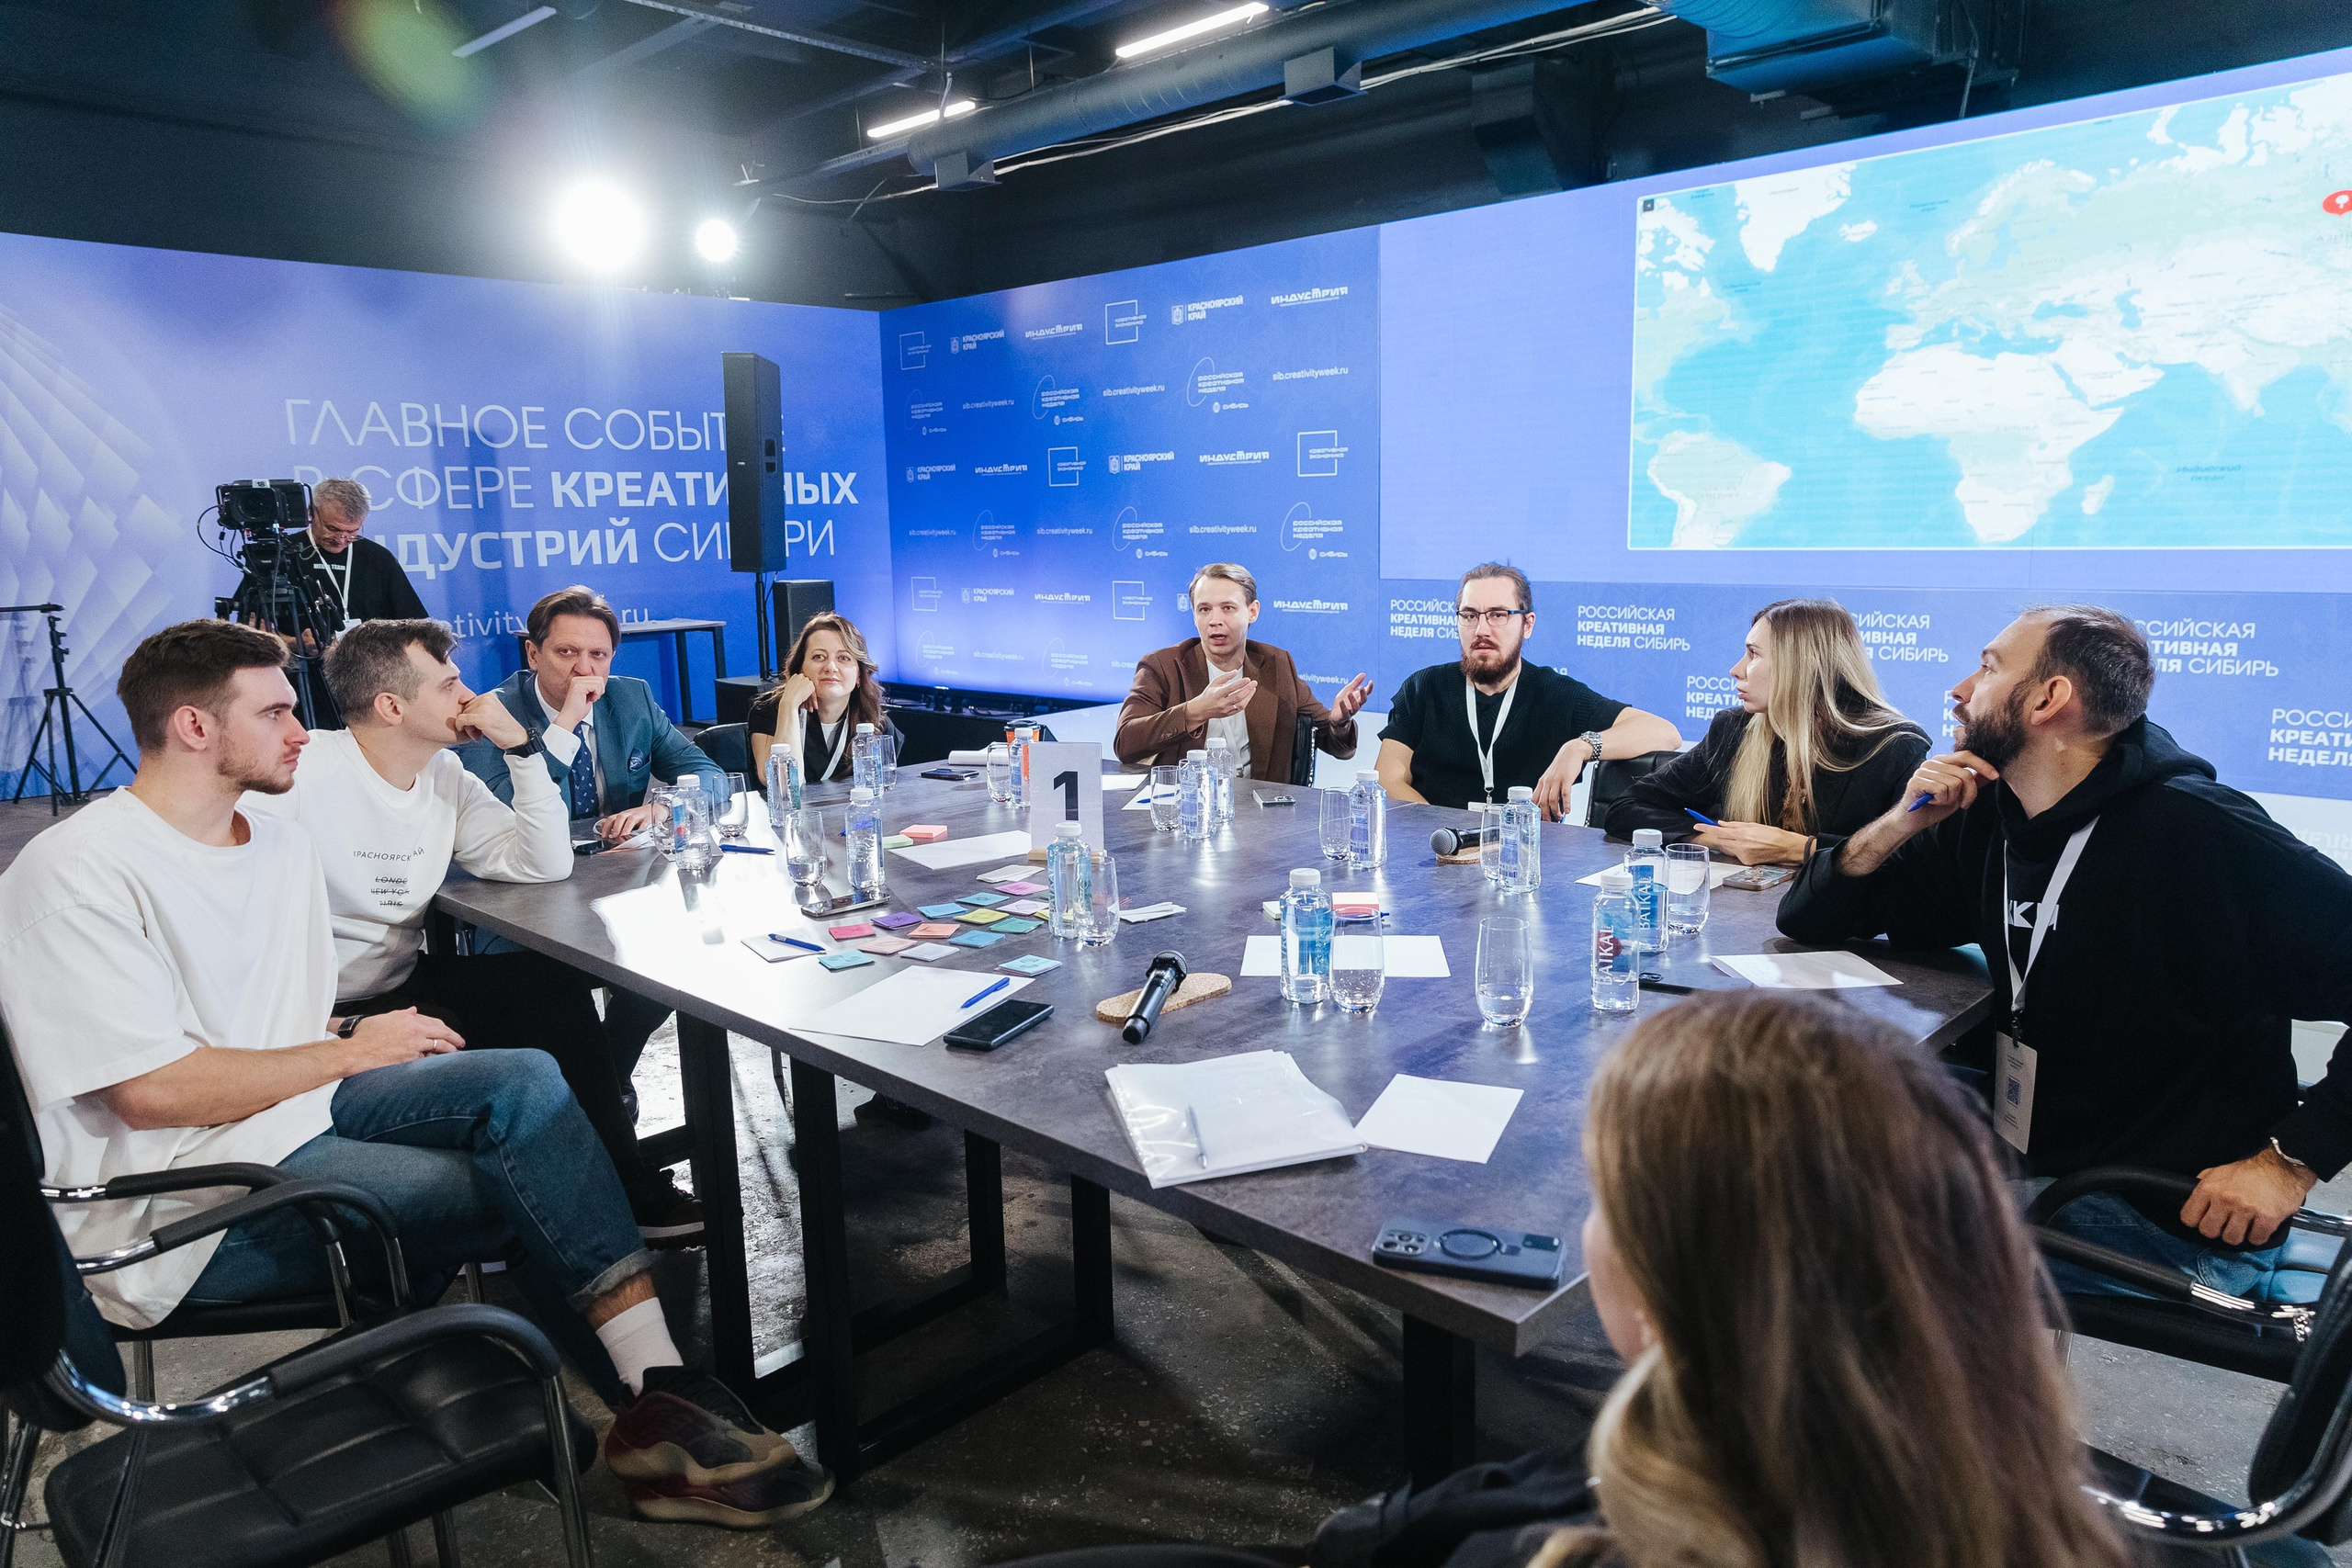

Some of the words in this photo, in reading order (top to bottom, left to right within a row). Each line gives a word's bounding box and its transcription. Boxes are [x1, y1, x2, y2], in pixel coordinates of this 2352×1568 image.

[1188, 295, 1243, 311] КРАСНОЯРСКИЙ
[1188, 310, 1206, 321] КРАЙ
[1272, 367, 1349, 381] sib.creativityweek.ru
[1102, 384, 1165, 397] sib.creativityweek.ru
[285, 399, 548, 448] ГЛАВНОЕ
[564, 407, 786, 452] СОБЫТ
[1124, 451, 1174, 462] КРАСНОЯРСКИЙ
[1124, 461, 1141, 471] КРАЙ
[551, 471, 860, 508] КРЕАТИЫХ
[1036, 527, 1092, 536] sib.creativityweek.ru
[1189, 525, 1257, 536] sib.creativityweek.ru
[375, 517, 638, 580] ДУСТРИЙ
[653, 519, 834, 562] СИРИ
[1390, 598, 1455, 613] РОССИЙСК
[1577, 604, 1675, 621] РОССИЙСКАЯ
[1850, 610, 1930, 629] ИЙСКАЯ
[1390, 626, 1434, 638] НЕДЕЛЯ
[1577, 621, 1665, 635] КРЕАТИВНАЯ
[2134, 617, 2256, 639] СИЙСКАЯ
[1577, 635, 1631, 649] НЕДЕЛЯ
[1634, 636, 1690, 651] СИБИРЬ
[1859, 631, 1917, 645] ИВНАЯ
[1878, 646, 1950, 663] СИБИРЬ
[2151, 639, 2238, 657] ТИВНАЯ
[2188, 657, 2279, 677] СИБИРЬ
[1687, 675, 1738, 691] РОССИ
[1686, 691, 1745, 705] КРЕАТИ
[1686, 705, 1724, 720] НЕД
[2268, 747, 2352, 766] НЕДЕЛ
[1053, 771, 1079, 821] 1
[354, 851, 412, 862] КРАСНОЯРСК
[375, 876, 408, 885] LONDO
[1639, 875, 1652, 931] BAIKAL
[1598, 925, 1614, 986] BAIKAL
